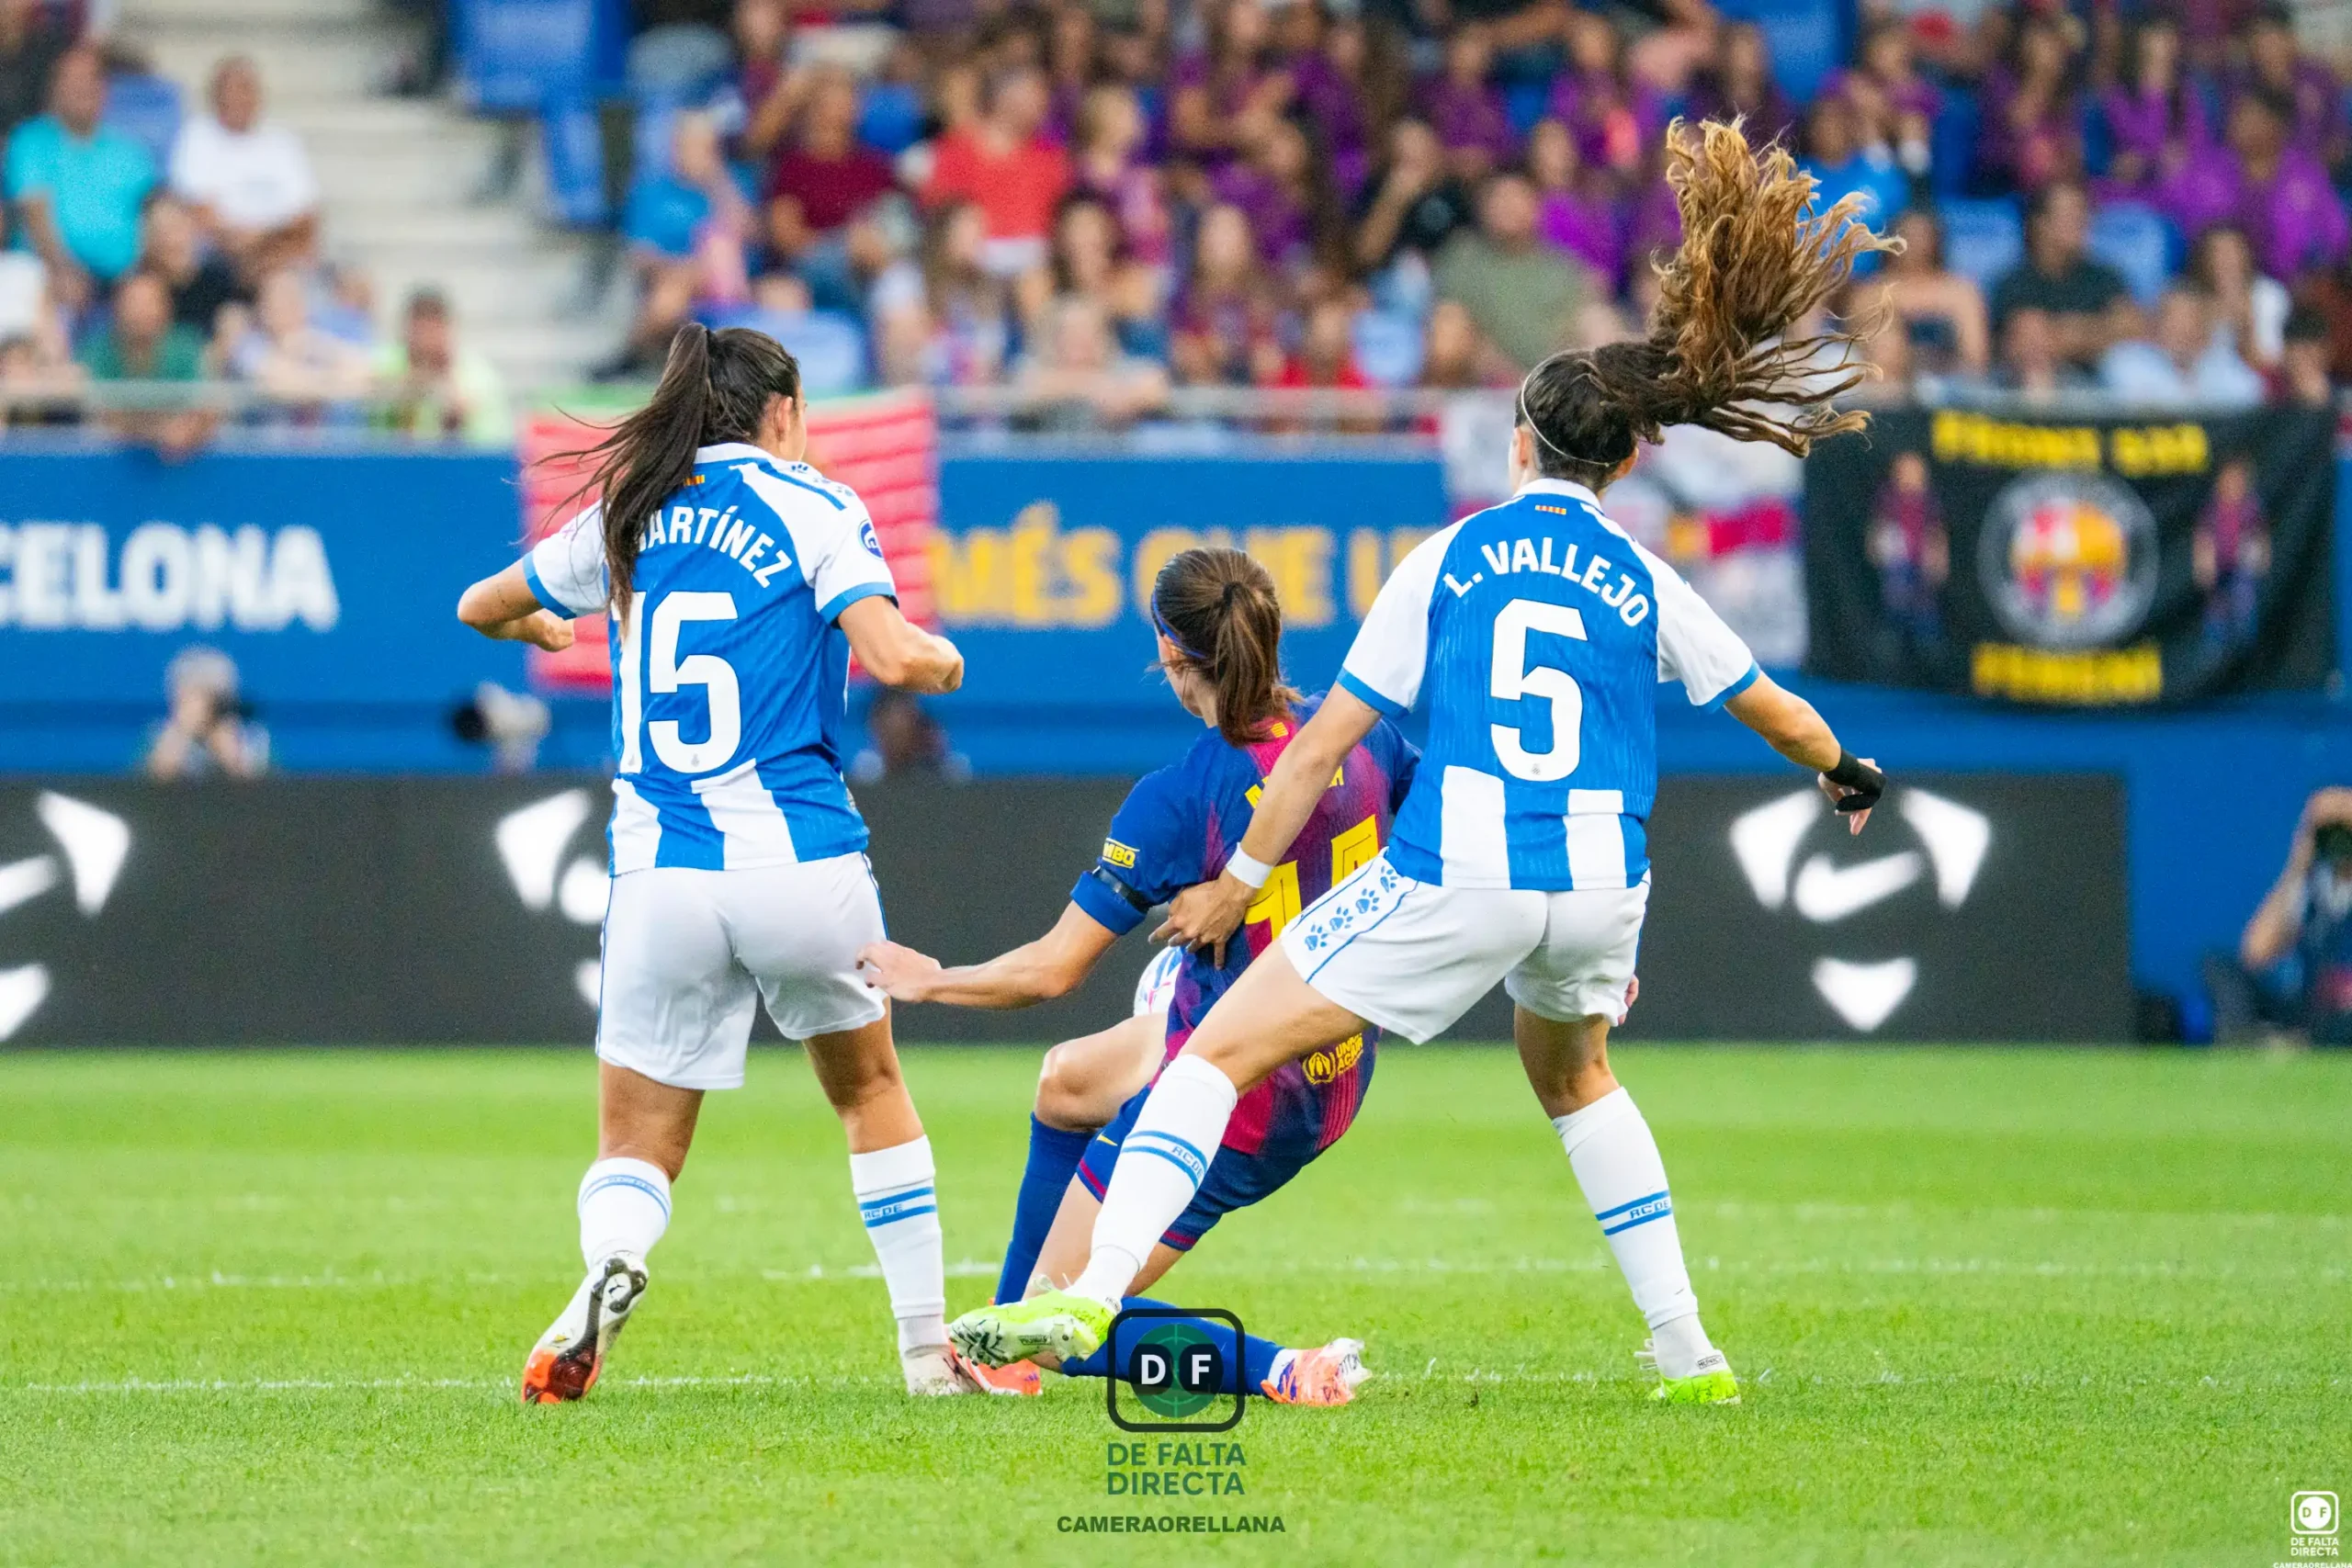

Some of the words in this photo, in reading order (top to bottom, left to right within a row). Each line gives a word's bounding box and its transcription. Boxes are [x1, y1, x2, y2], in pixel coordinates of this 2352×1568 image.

[639, 505, 792, 589] ARTÍNEZ
[1443, 570, 1484, 598] L.
[1481, 537, 1649, 627] VALLEJO
[611, 591, 741, 773] 15
[1491, 598, 1588, 781] 5
